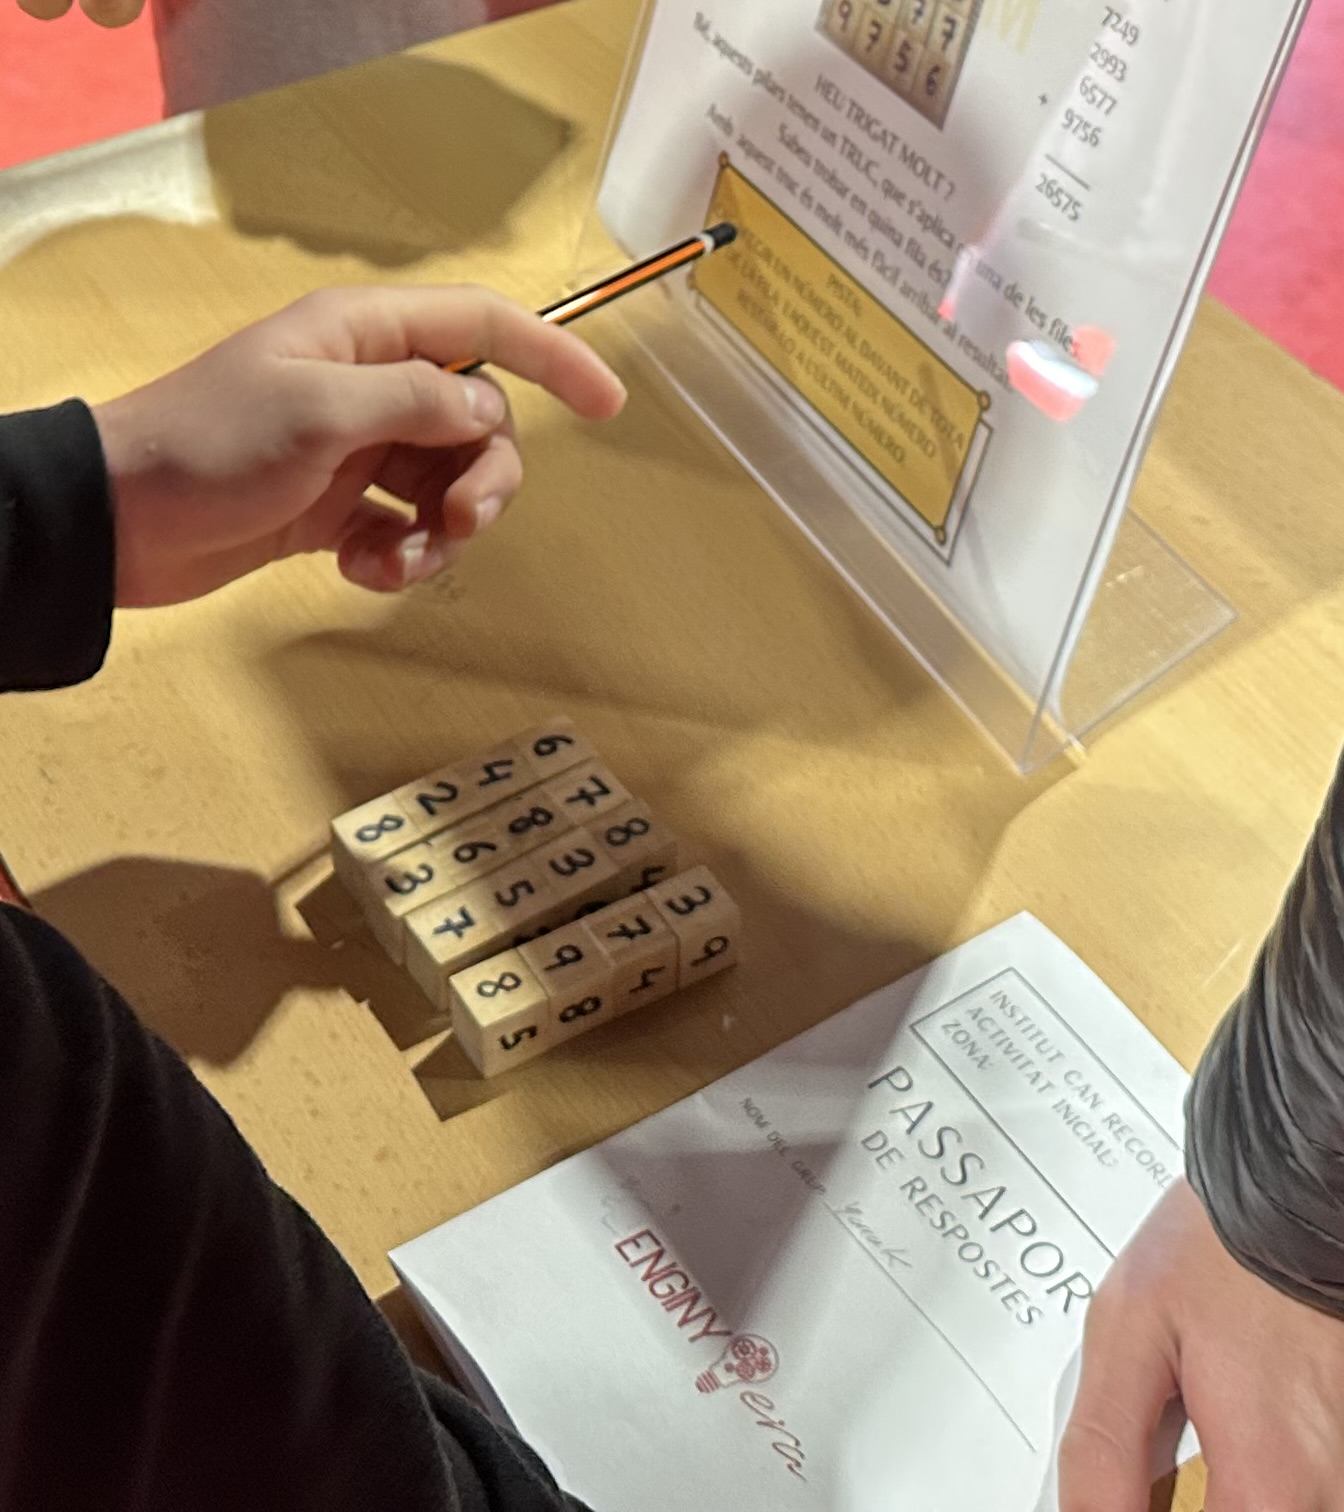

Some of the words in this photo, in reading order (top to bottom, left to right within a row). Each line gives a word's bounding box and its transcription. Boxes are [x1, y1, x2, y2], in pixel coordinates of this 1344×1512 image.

[865, 18, 882, 52] 7
[893, 38, 911, 74] 5
[925, 64, 941, 96] 6
[939, 15, 957, 53] 7
[1100, 4, 1139, 47] 7249
[1078, 74, 1118, 117] 6577
[1088, 40, 1127, 83] 2993
[844, 97, 900, 155] TRIGAT
[897, 143, 945, 192] MOLT
[1060, 107, 1102, 148] 9756
[1034, 171, 1083, 222] 26575
[843, 228, 870, 261] més
[866, 208, 904, 249] quina
[904, 235, 927, 269] fila
[880, 176, 906, 208] que
[1002, 281, 1025, 311] de
[1024, 294, 1048, 330] les
[965, 1006, 1054, 1094] ACTIVITAT
[988, 989, 1064, 1063] INSTITUT
[1062, 1069, 1102, 1111] CAN
[866, 1064, 1098, 1314] PASSAPOR
[859, 1128, 905, 1170] DE
[898, 1174, 1044, 1326] RESPOSTES
[613, 1227, 733, 1343] ENGINY
